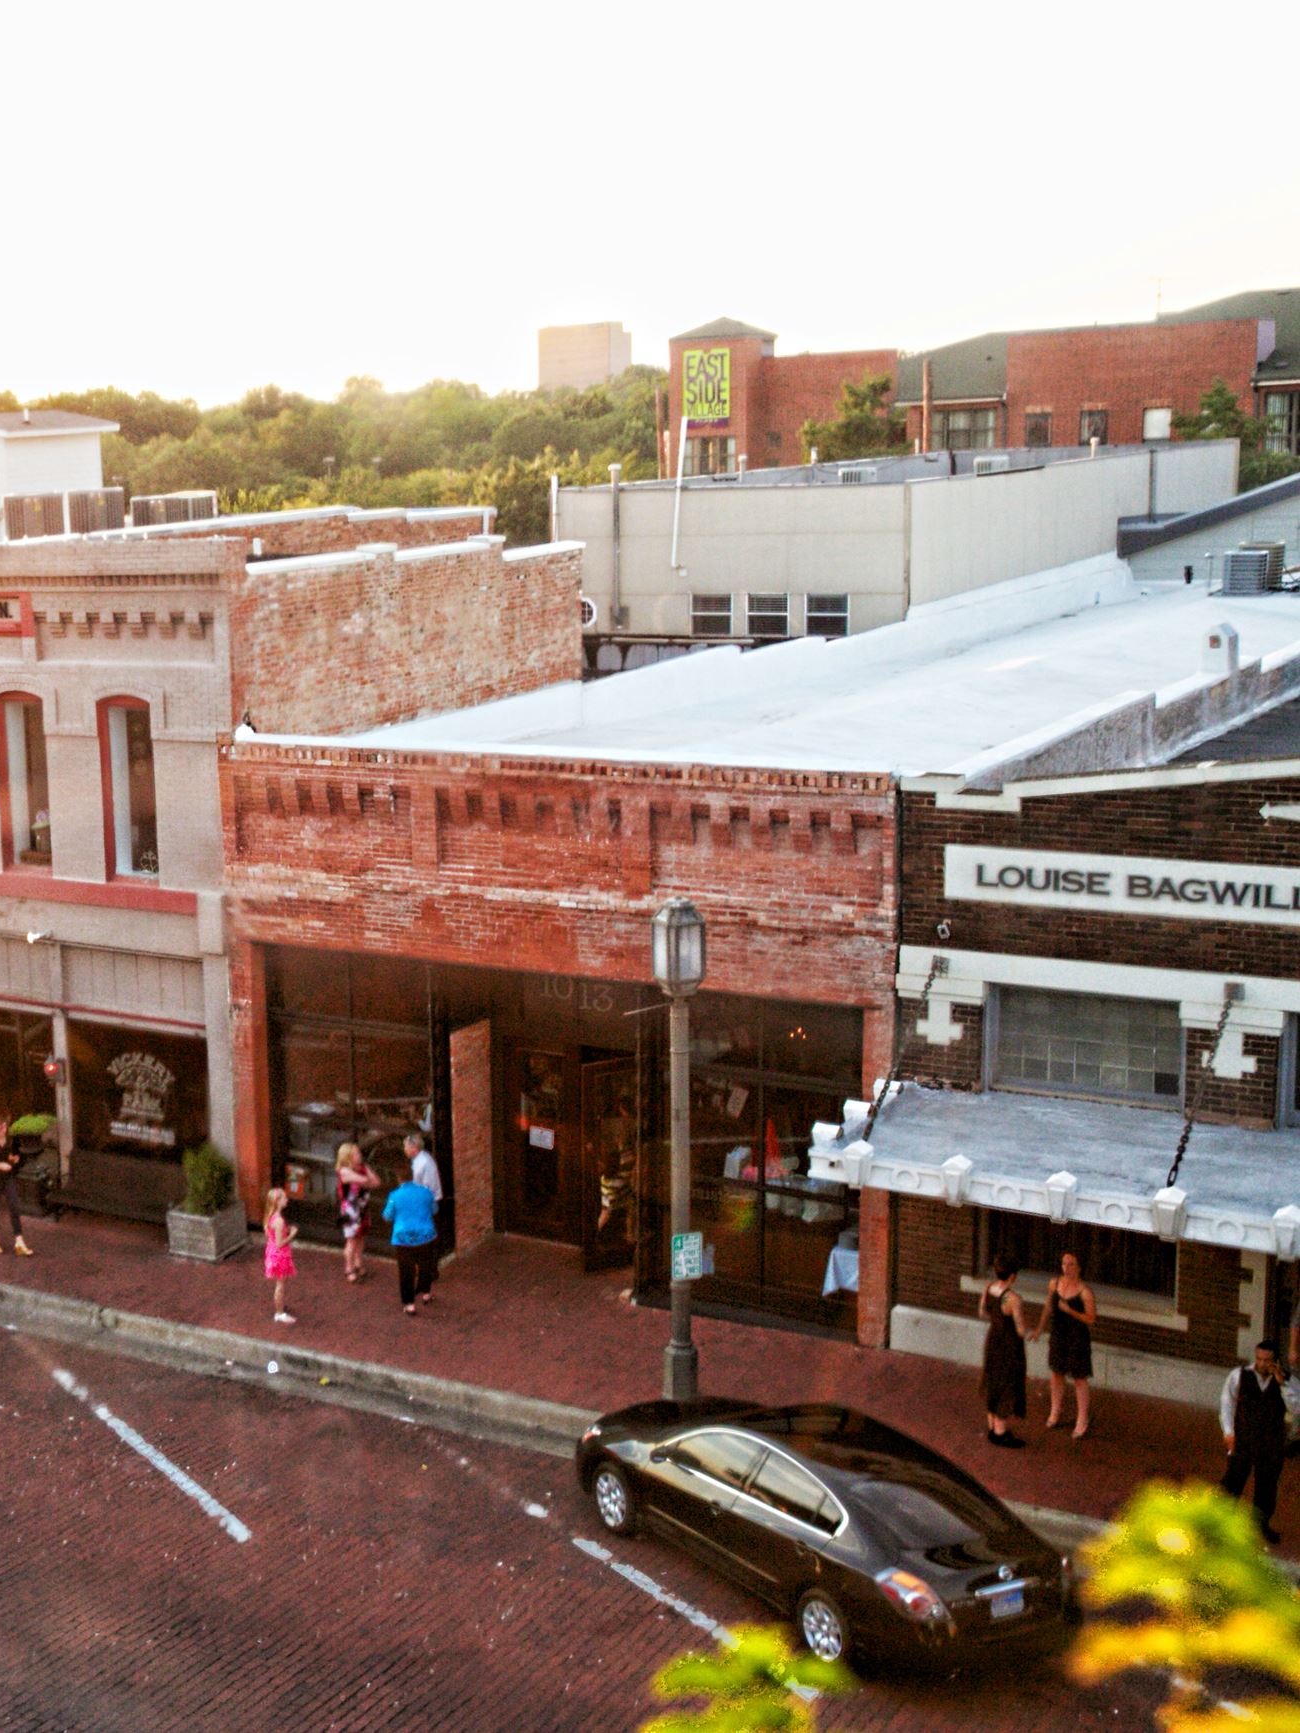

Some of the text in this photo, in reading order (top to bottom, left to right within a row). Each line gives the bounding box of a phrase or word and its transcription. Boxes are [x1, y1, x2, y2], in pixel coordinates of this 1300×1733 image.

[686, 352, 728, 380] EAST
[686, 378, 728, 405] SIDE
[686, 401, 728, 417] VILLAGE
[975, 863, 1112, 897] LOUISE
[107, 1052, 176, 1085] VICKERY
